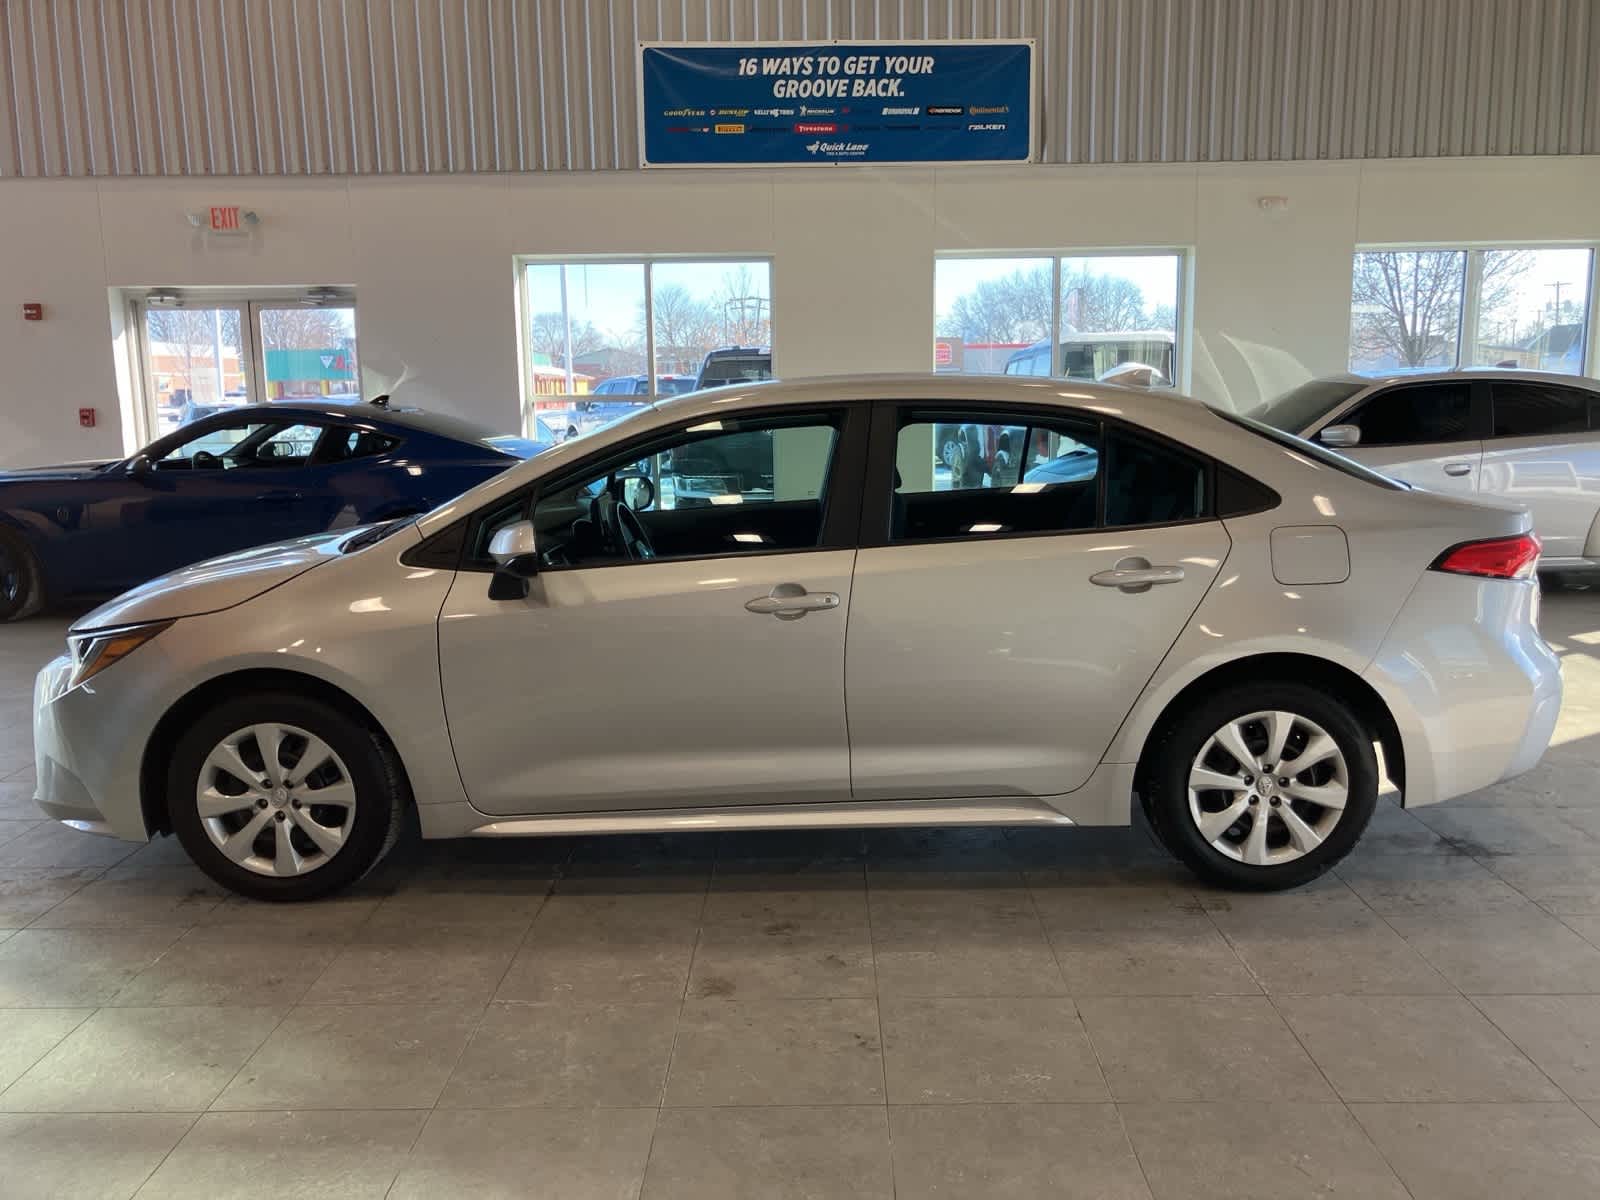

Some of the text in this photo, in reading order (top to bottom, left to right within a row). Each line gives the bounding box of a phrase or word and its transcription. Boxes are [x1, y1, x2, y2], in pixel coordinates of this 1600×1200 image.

[738, 56, 935, 76] 16 WAYS TO GET YOUR
[773, 78, 905, 98] GROOVE BACK.
[663, 108, 705, 118] GOODYEAR
[820, 142, 870, 152] Quick Lane
[210, 207, 240, 230] EXIT
